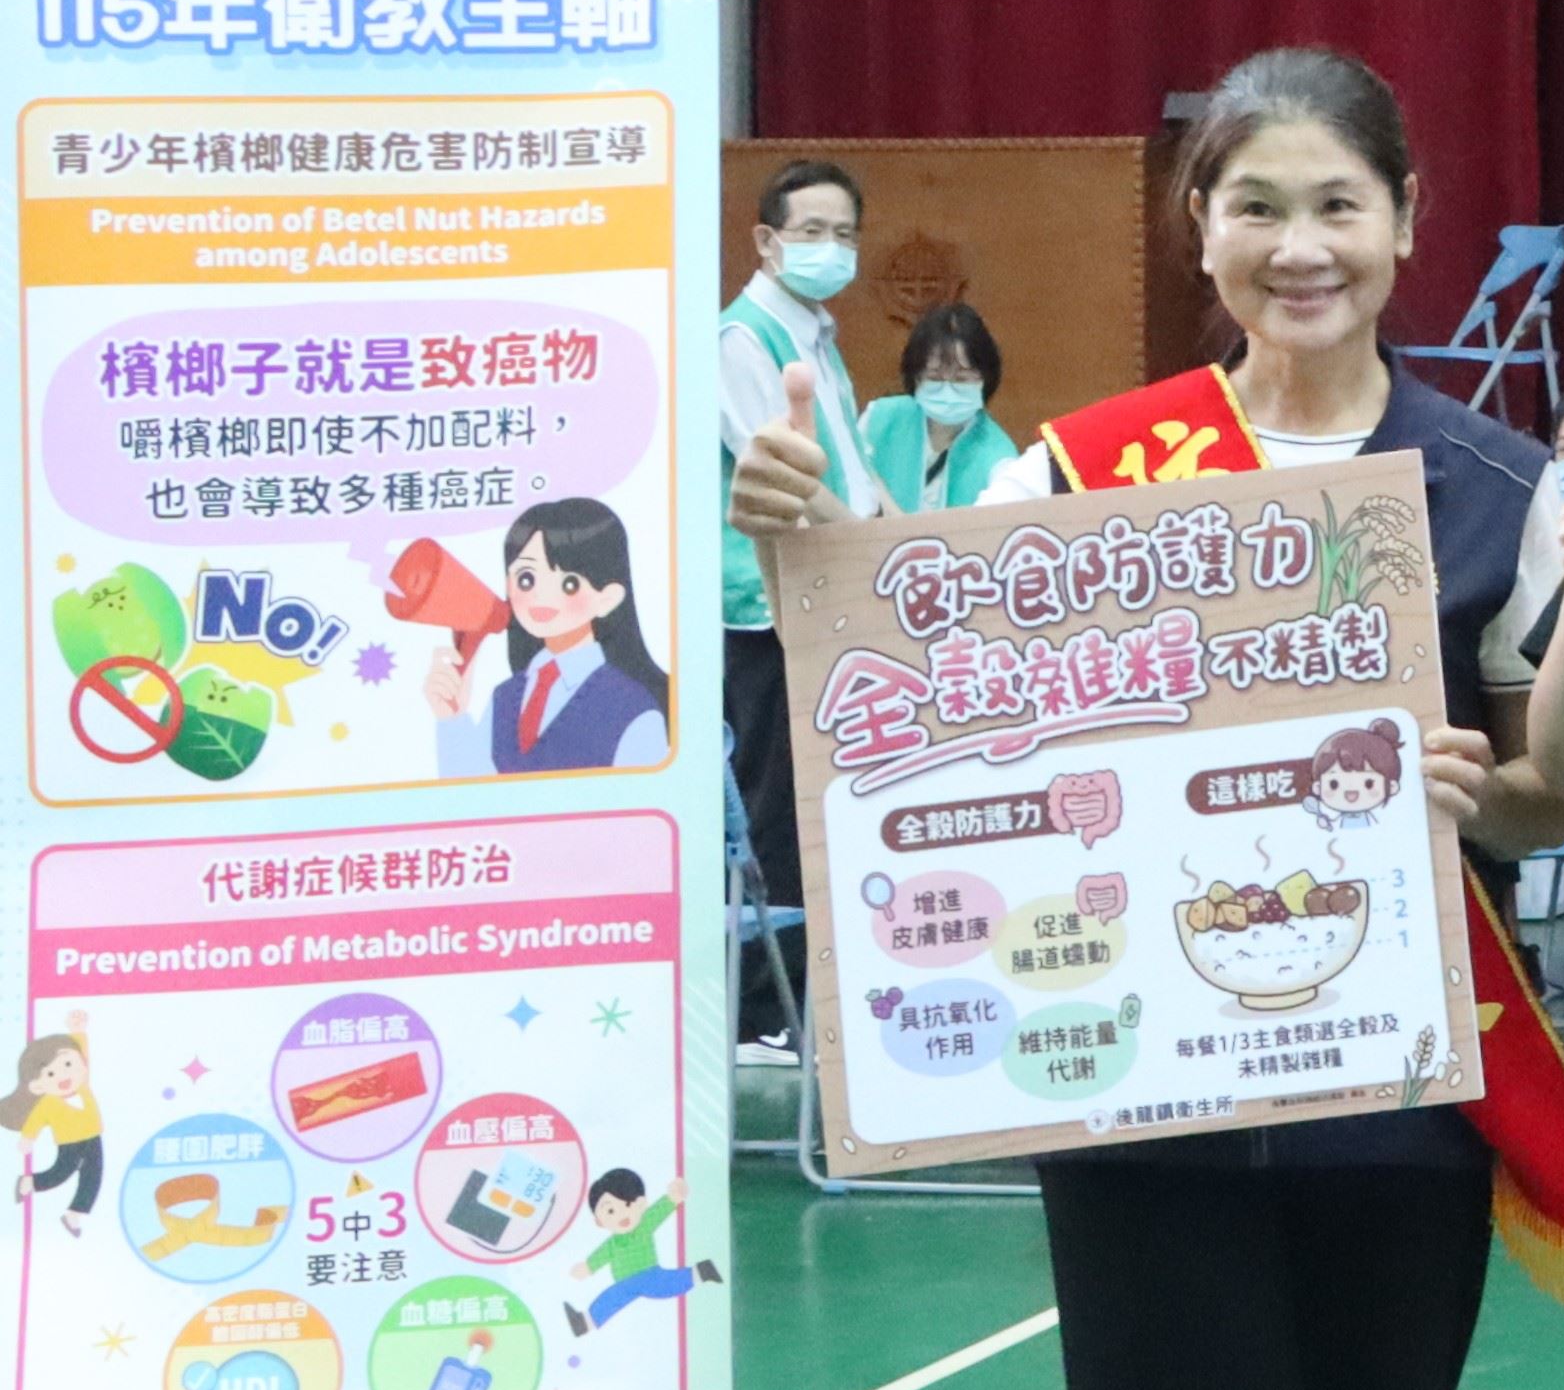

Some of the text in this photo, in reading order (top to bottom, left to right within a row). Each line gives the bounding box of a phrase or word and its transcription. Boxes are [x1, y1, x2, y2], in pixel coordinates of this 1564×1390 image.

[53, 125, 648, 175] 青少年檳榔健康危害防制宣導
[91, 199, 605, 235] Prevention of Betel Nut Hazards
[195, 238, 509, 273] among Adolescents
[101, 330, 599, 399] 檳榔子就是致癌物
[875, 502, 1314, 638] 飲食防護力
[1207, 772, 1297, 807] 這樣吃
[896, 801, 1043, 845] 全穀防護力
[203, 844, 512, 903] 代謝症候群防治
[1391, 868, 1406, 889] 3
[913, 888, 963, 916] 增進
[1394, 899, 1408, 919] 2
[891, 916, 990, 950] 皮膚健康
[1033, 913, 1083, 940] 促進
[56, 917, 654, 976] Prevention of Metabolic Syndrome
[302, 1015, 410, 1045] 血脂偏高
[898, 998, 998, 1032] 具抗氧化
[925, 1032, 975, 1060] 作用
[1018, 1020, 1119, 1055] 維持能量
[1046, 1055, 1096, 1084] 代謝
[446, 1114, 555, 1145] 血壓偏高
[306, 1249, 408, 1287] 要注意
[399, 1295, 509, 1326] 血糖偏高
